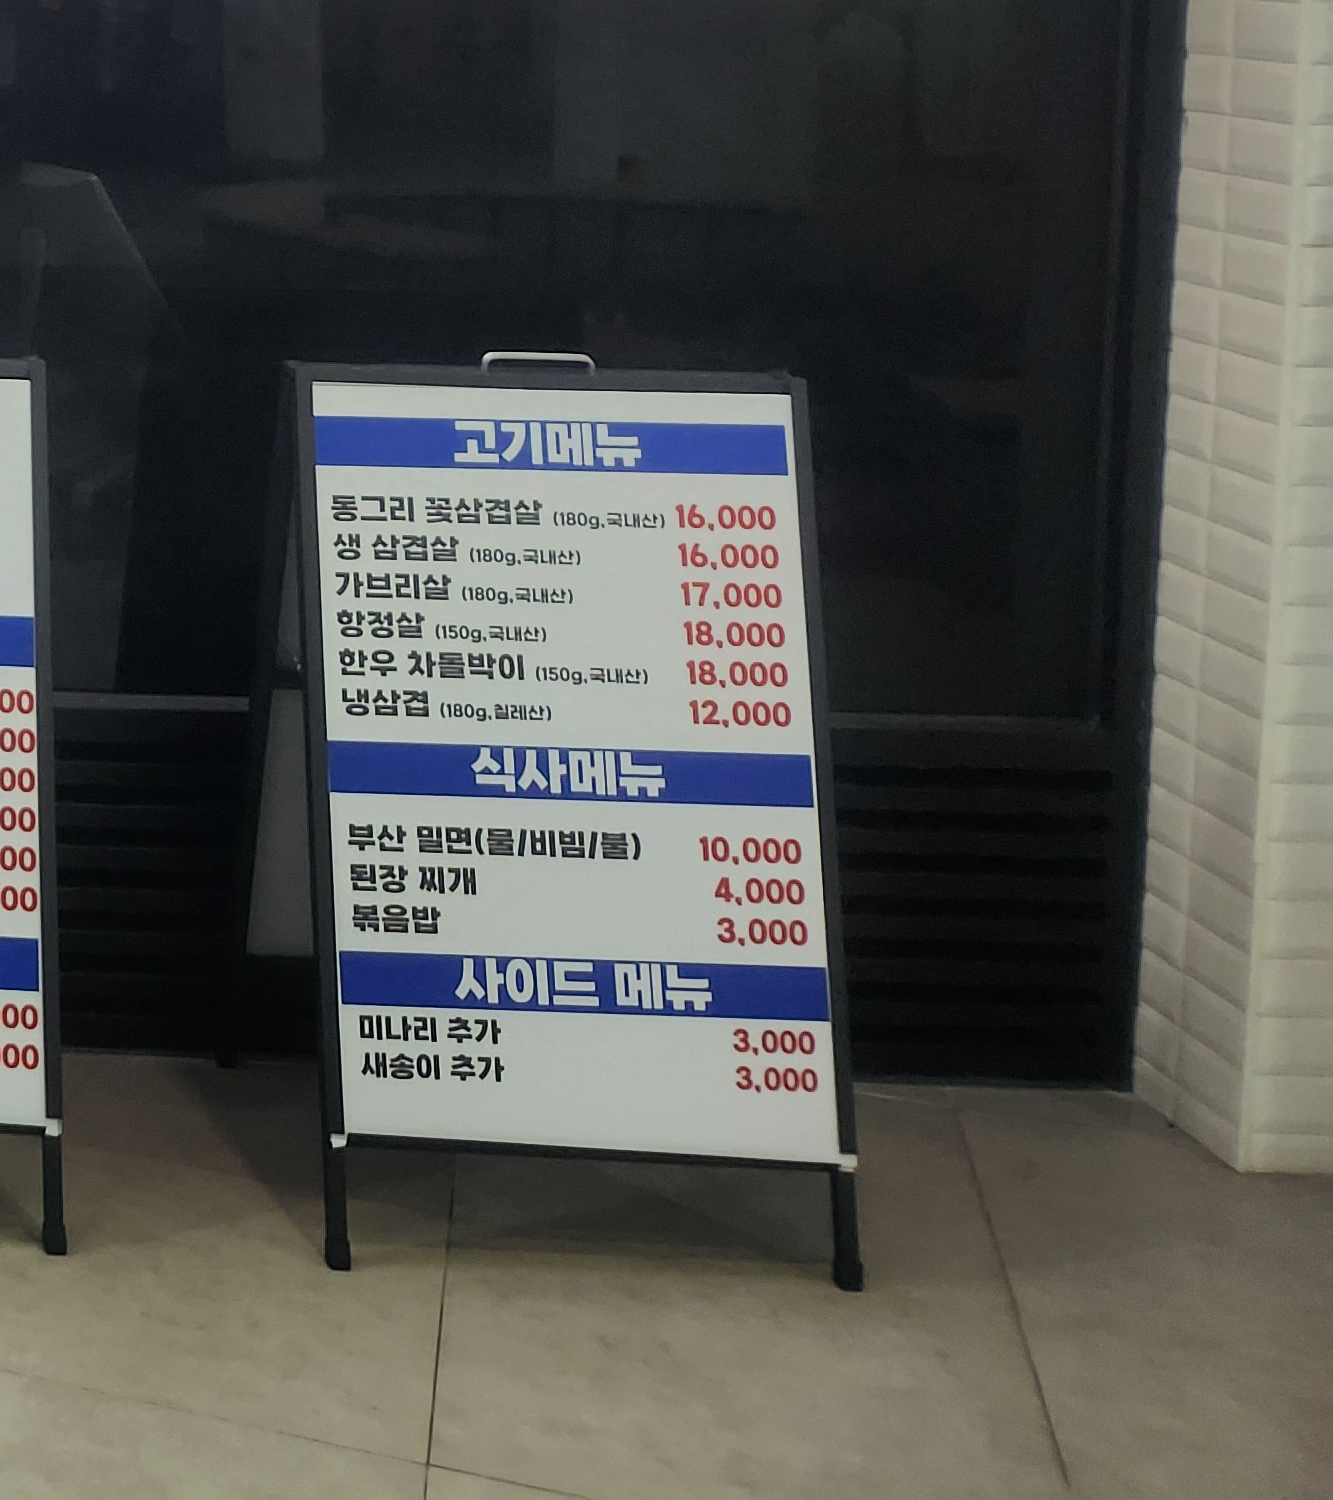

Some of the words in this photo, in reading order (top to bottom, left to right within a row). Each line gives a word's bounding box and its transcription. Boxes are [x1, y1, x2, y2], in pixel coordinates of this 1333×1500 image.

[453, 420, 642, 467] 고기메뉴
[330, 495, 415, 523] 동그리
[425, 497, 543, 527] 꽃삼겹살
[675, 504, 777, 532] 16,000
[333, 533, 362, 561] 생
[371, 534, 460, 563] 삼겹살
[678, 543, 780, 571] 16,000
[335, 572, 452, 601] 가브리살
[680, 581, 783, 610] 17,000
[336, 610, 426, 640] 항정살
[683, 620, 786, 649] 18,000
[338, 648, 398, 678] 한우
[407, 650, 526, 681] 차돌박이
[686, 659, 789, 689] 18,000
[341, 688, 430, 718] 냉삼겹
[689, 699, 792, 729] 12,000
[471, 746, 666, 798] 식사메뉴
[347, 823, 407, 854] 부산
[416, 825, 642, 861] 밀면(물/비빔/불)
[699, 835, 803, 865] 10,000
[350, 863, 409, 894] 된장
[419, 865, 478, 896] 찌개
[714, 876, 805, 906] 4,000
[352, 904, 441, 935] 볶음밥
[716, 917, 809, 947] 3,000
[455, 957, 600, 1008] 사이드
[614, 963, 713, 1012] 메뉴
[359, 1014, 437, 1044] 미나리
[447, 1016, 502, 1045] 추가
[732, 1027, 816, 1057] 3,000
[361, 1052, 441, 1081] 새송이
[450, 1053, 506, 1084] 추가
[735, 1066, 819, 1095] 3,000
